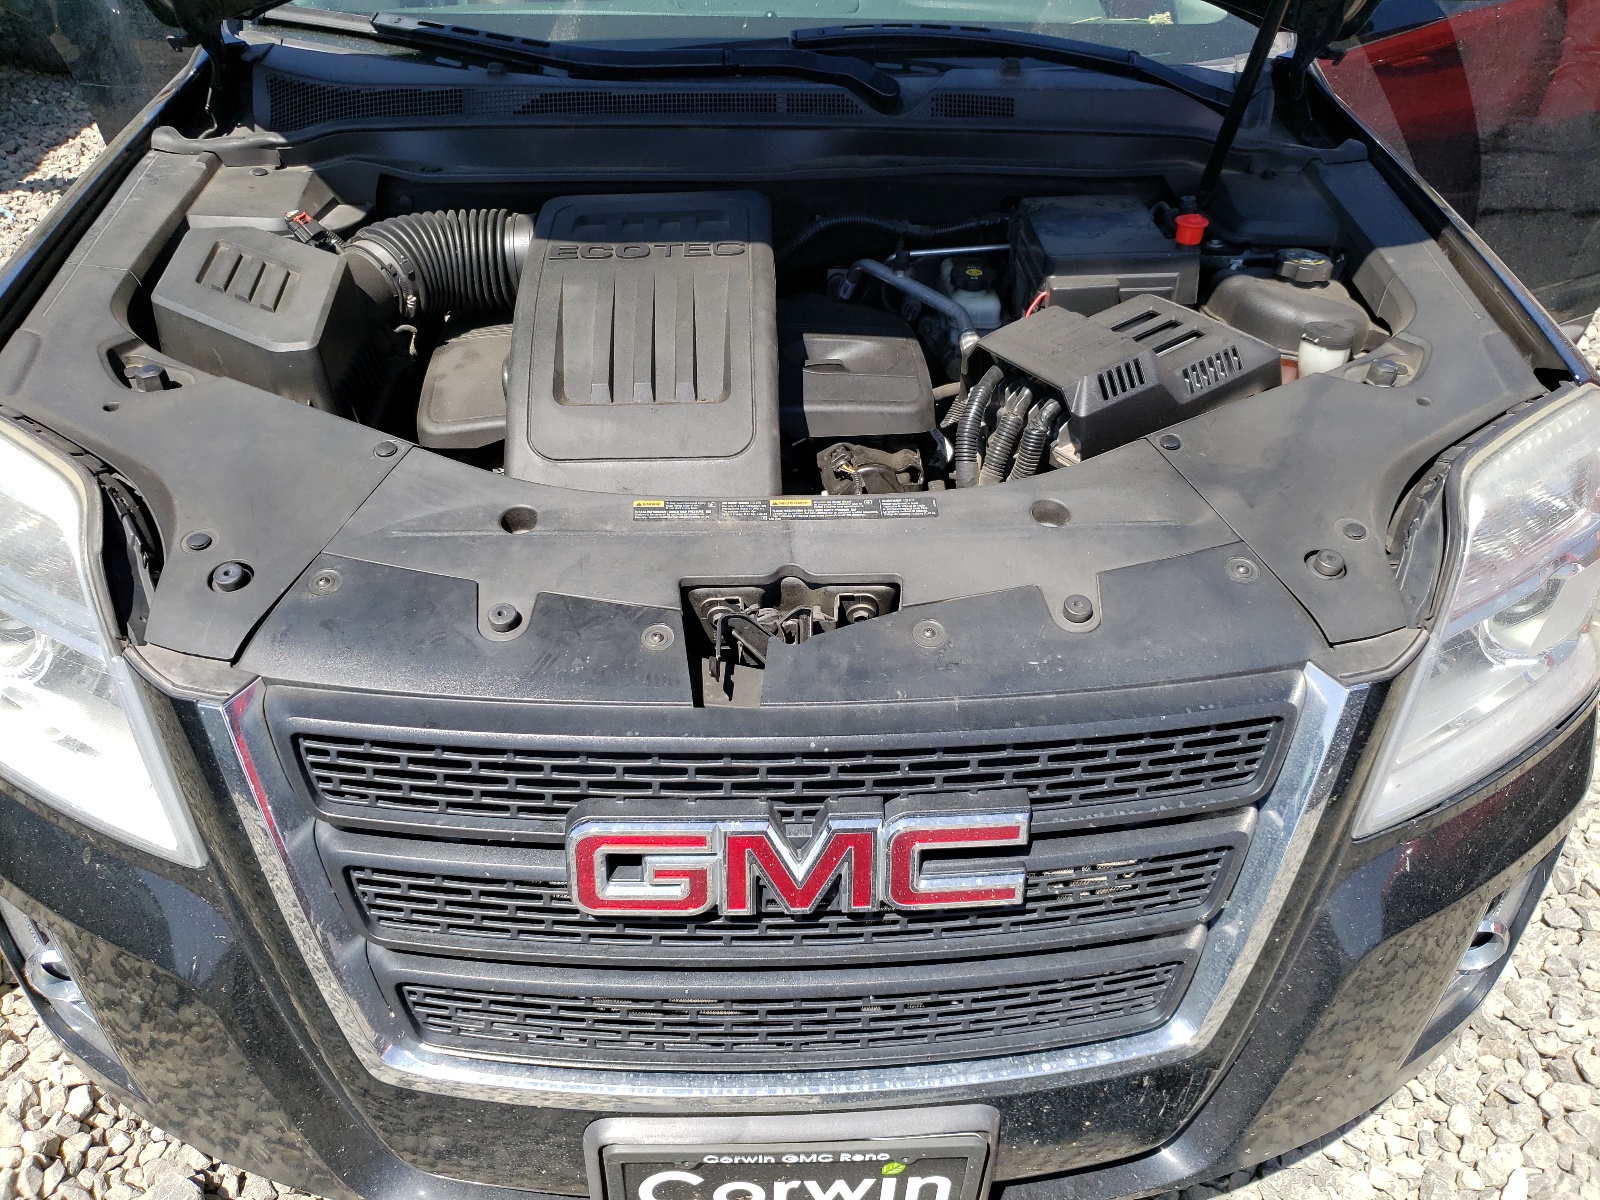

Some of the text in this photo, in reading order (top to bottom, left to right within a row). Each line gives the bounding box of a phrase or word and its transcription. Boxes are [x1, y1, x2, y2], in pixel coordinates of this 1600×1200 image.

[549, 240, 745, 260] ECOTEC
[567, 809, 1029, 916] GMC
[703, 1152, 891, 1164] Corwin GMC Reno
[638, 1164, 952, 1200] Corwin
